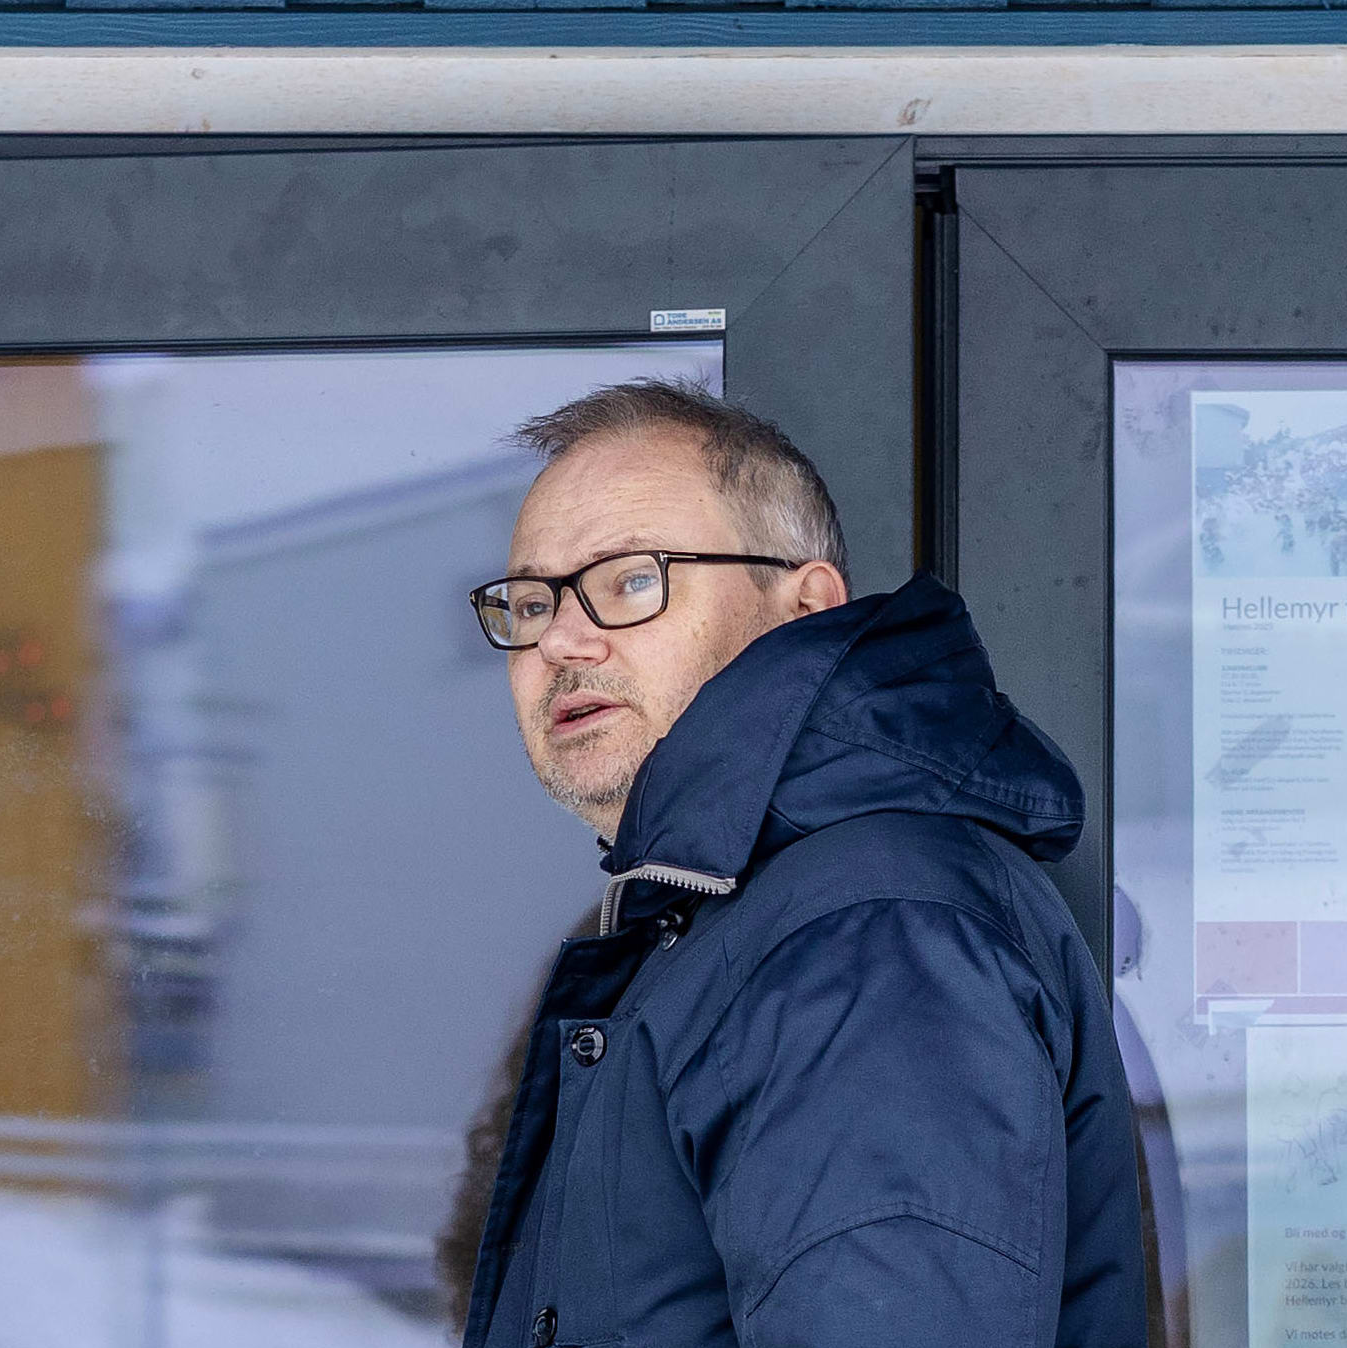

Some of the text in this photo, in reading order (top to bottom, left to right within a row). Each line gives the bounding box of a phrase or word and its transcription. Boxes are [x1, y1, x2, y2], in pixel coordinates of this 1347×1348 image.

[1222, 596, 1340, 624] Hellemyr
[1303, 1227, 1328, 1238] med
[1331, 1229, 1345, 1240] og
